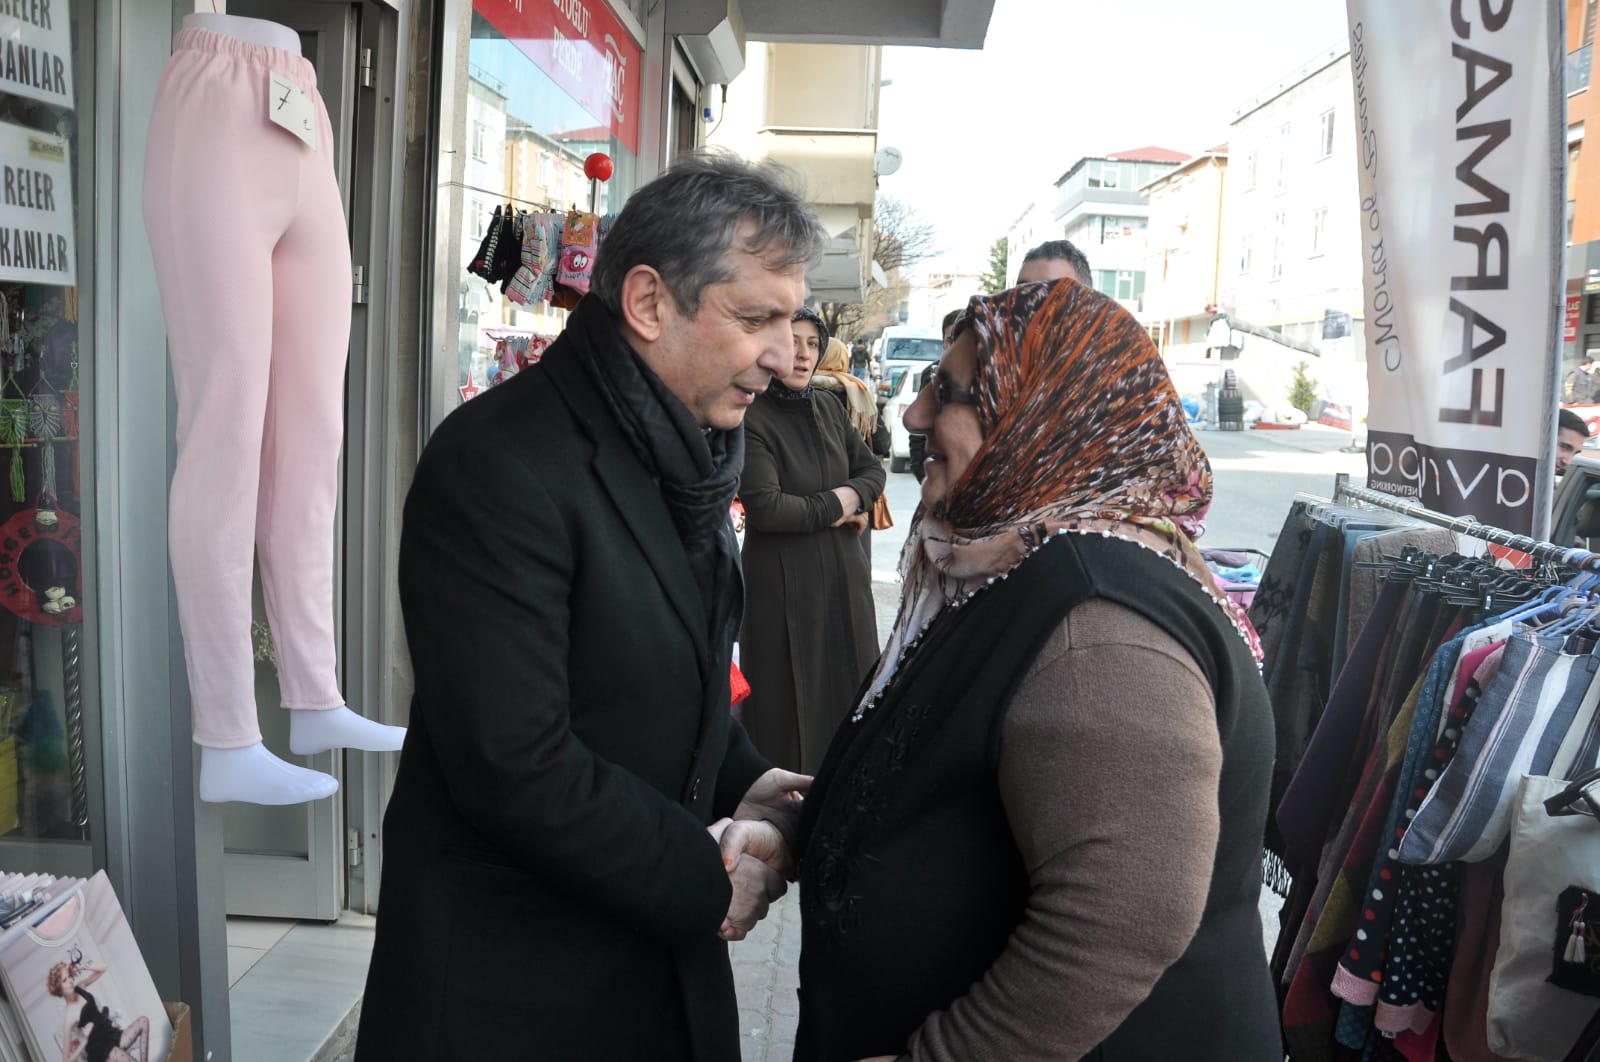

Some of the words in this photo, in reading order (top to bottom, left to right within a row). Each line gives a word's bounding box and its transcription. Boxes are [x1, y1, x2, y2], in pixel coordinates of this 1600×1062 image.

[0, 36, 66, 96] ANLAR
[553, 25, 583, 82] PERDE
[604, 48, 625, 111] TAÇ
